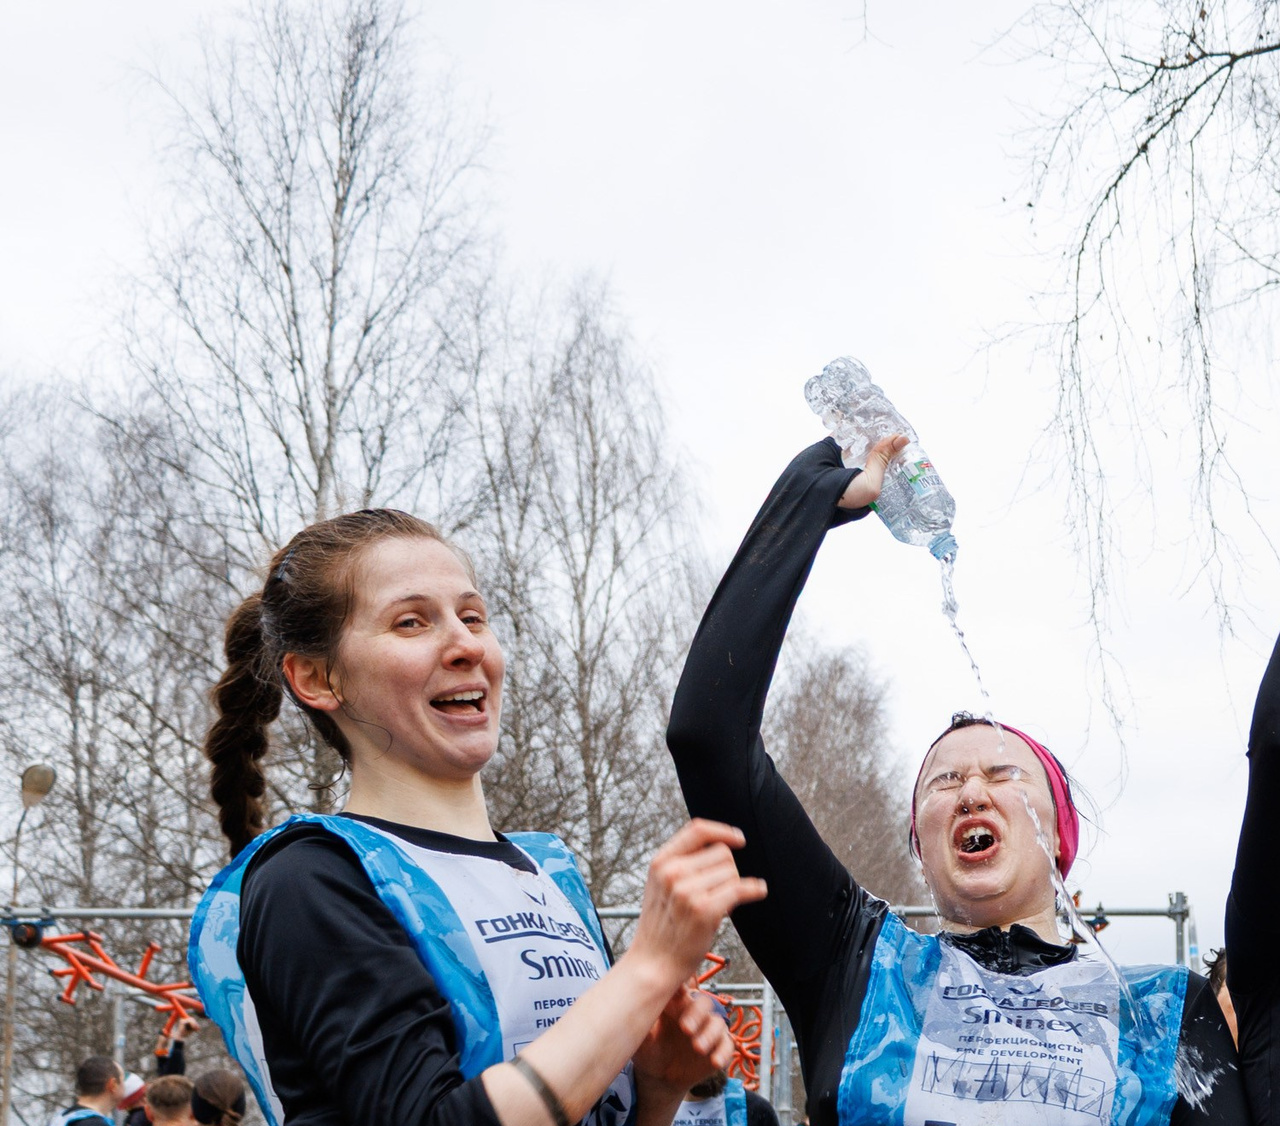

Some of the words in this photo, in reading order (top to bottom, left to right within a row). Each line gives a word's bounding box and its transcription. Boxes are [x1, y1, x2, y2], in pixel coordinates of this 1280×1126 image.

[475, 911, 548, 936] ГОНКА
[962, 1005, 1083, 1037] Sminex
[958, 1035, 1083, 1054] ПЕРФЕКЦИОНИСТЫ
[956, 1047, 985, 1056] FINE
[990, 1049, 1083, 1065] DEVELOPMENT
